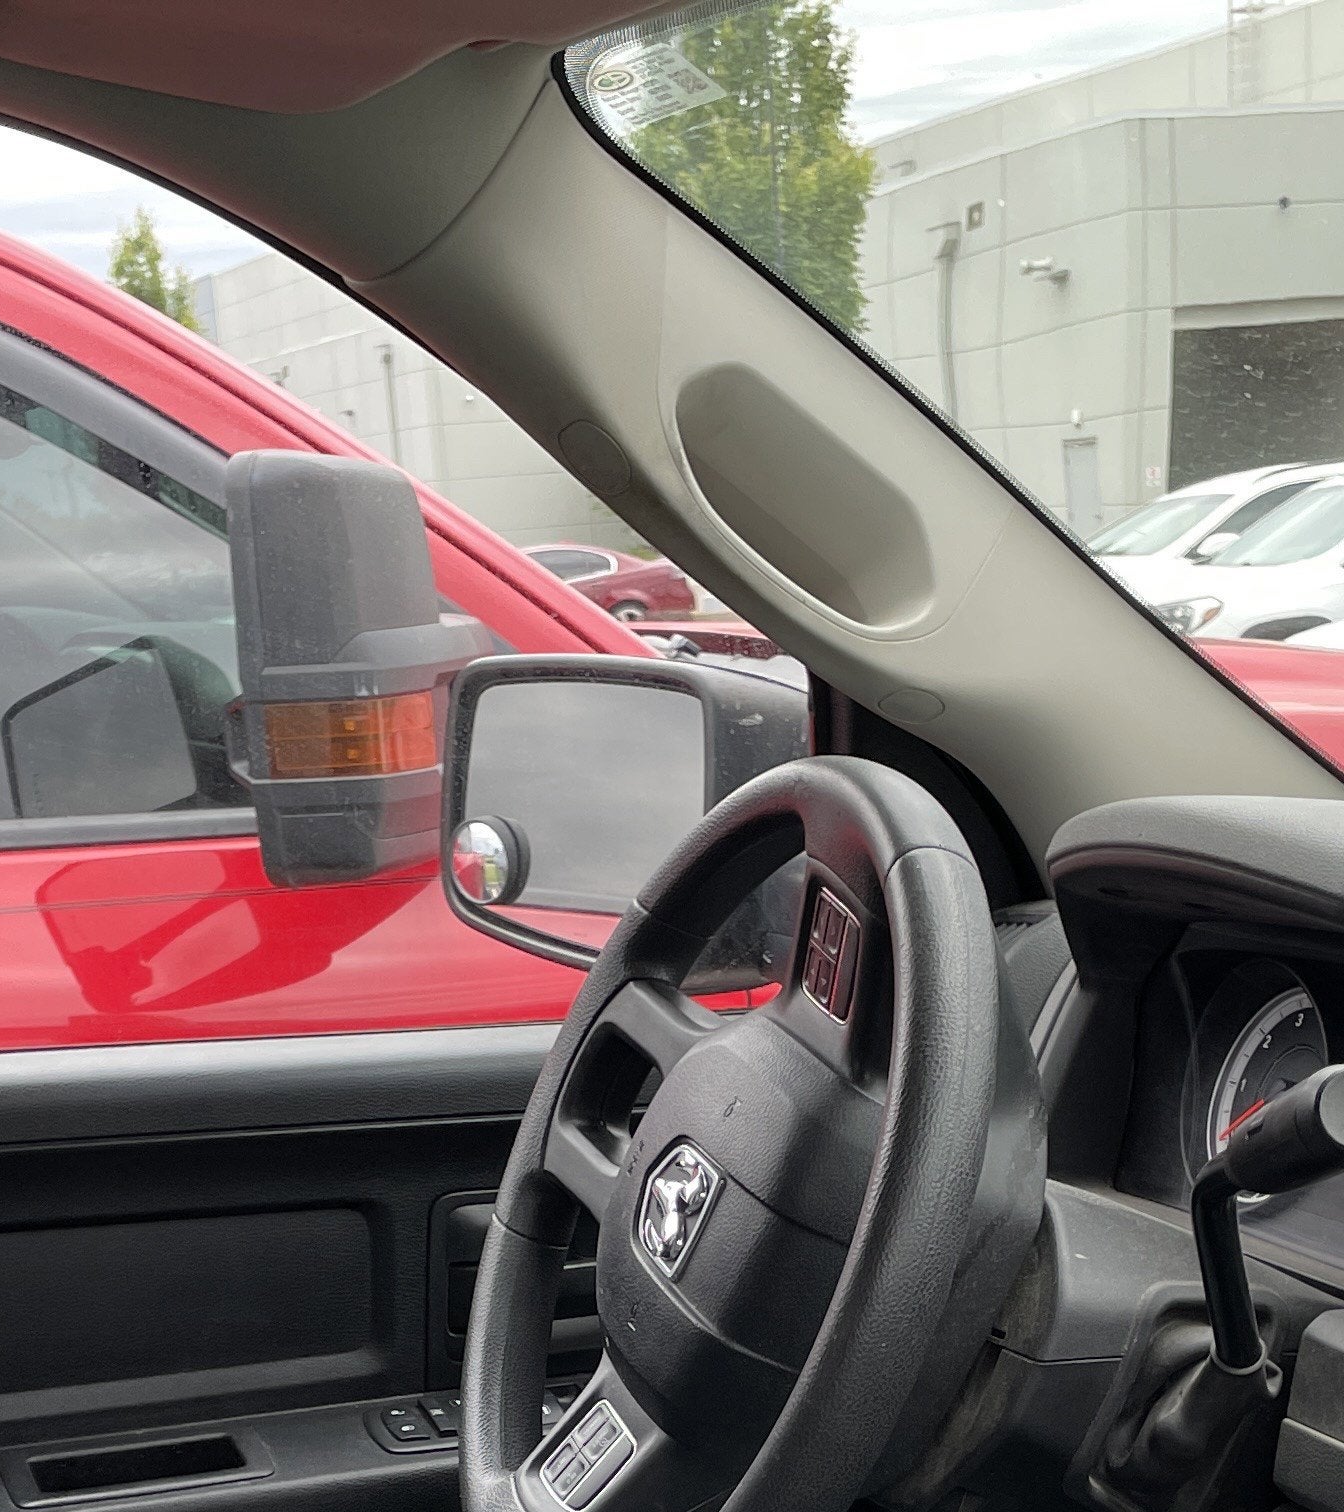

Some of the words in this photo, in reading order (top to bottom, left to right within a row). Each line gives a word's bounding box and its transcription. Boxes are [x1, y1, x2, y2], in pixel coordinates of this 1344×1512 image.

[1294, 1012, 1305, 1027] 3
[1262, 1034, 1273, 1049] 2
[1239, 1077, 1248, 1093] 1
